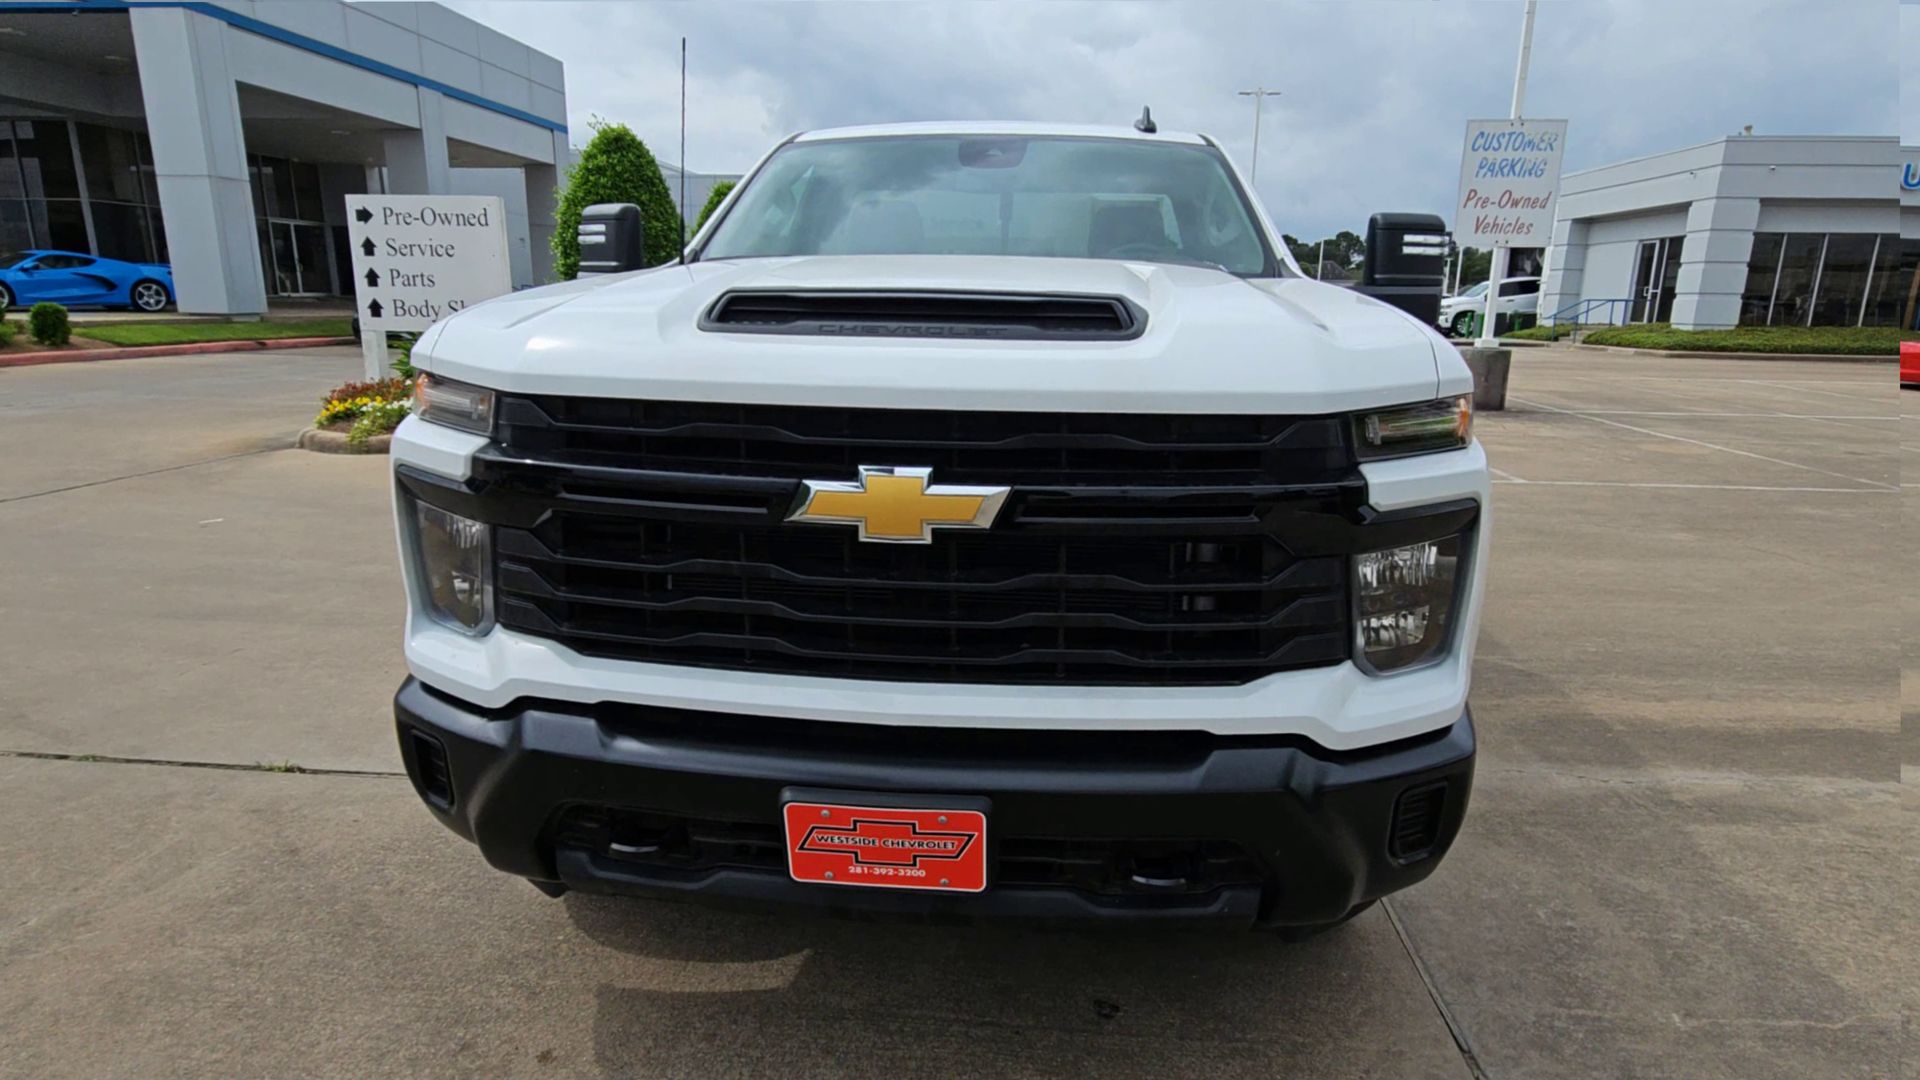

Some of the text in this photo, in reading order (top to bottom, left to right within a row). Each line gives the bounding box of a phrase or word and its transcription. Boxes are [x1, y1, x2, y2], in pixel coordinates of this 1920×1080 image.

[1471, 131, 1558, 152] CUSTOMER
[1475, 157, 1547, 178] PARKING
[1463, 188, 1552, 209] Pre-Owned
[382, 206, 489, 227] Pre-Owned
[1474, 215, 1534, 235] Vehicles
[385, 237, 455, 257] Service
[389, 268, 436, 288] Parts
[392, 299, 441, 322] Body
[818, 323, 1008, 337] CHEVROLET
[815, 833, 957, 850] WESTSIDE CHEVROLET
[848, 865, 926, 878] 281-392-3200
